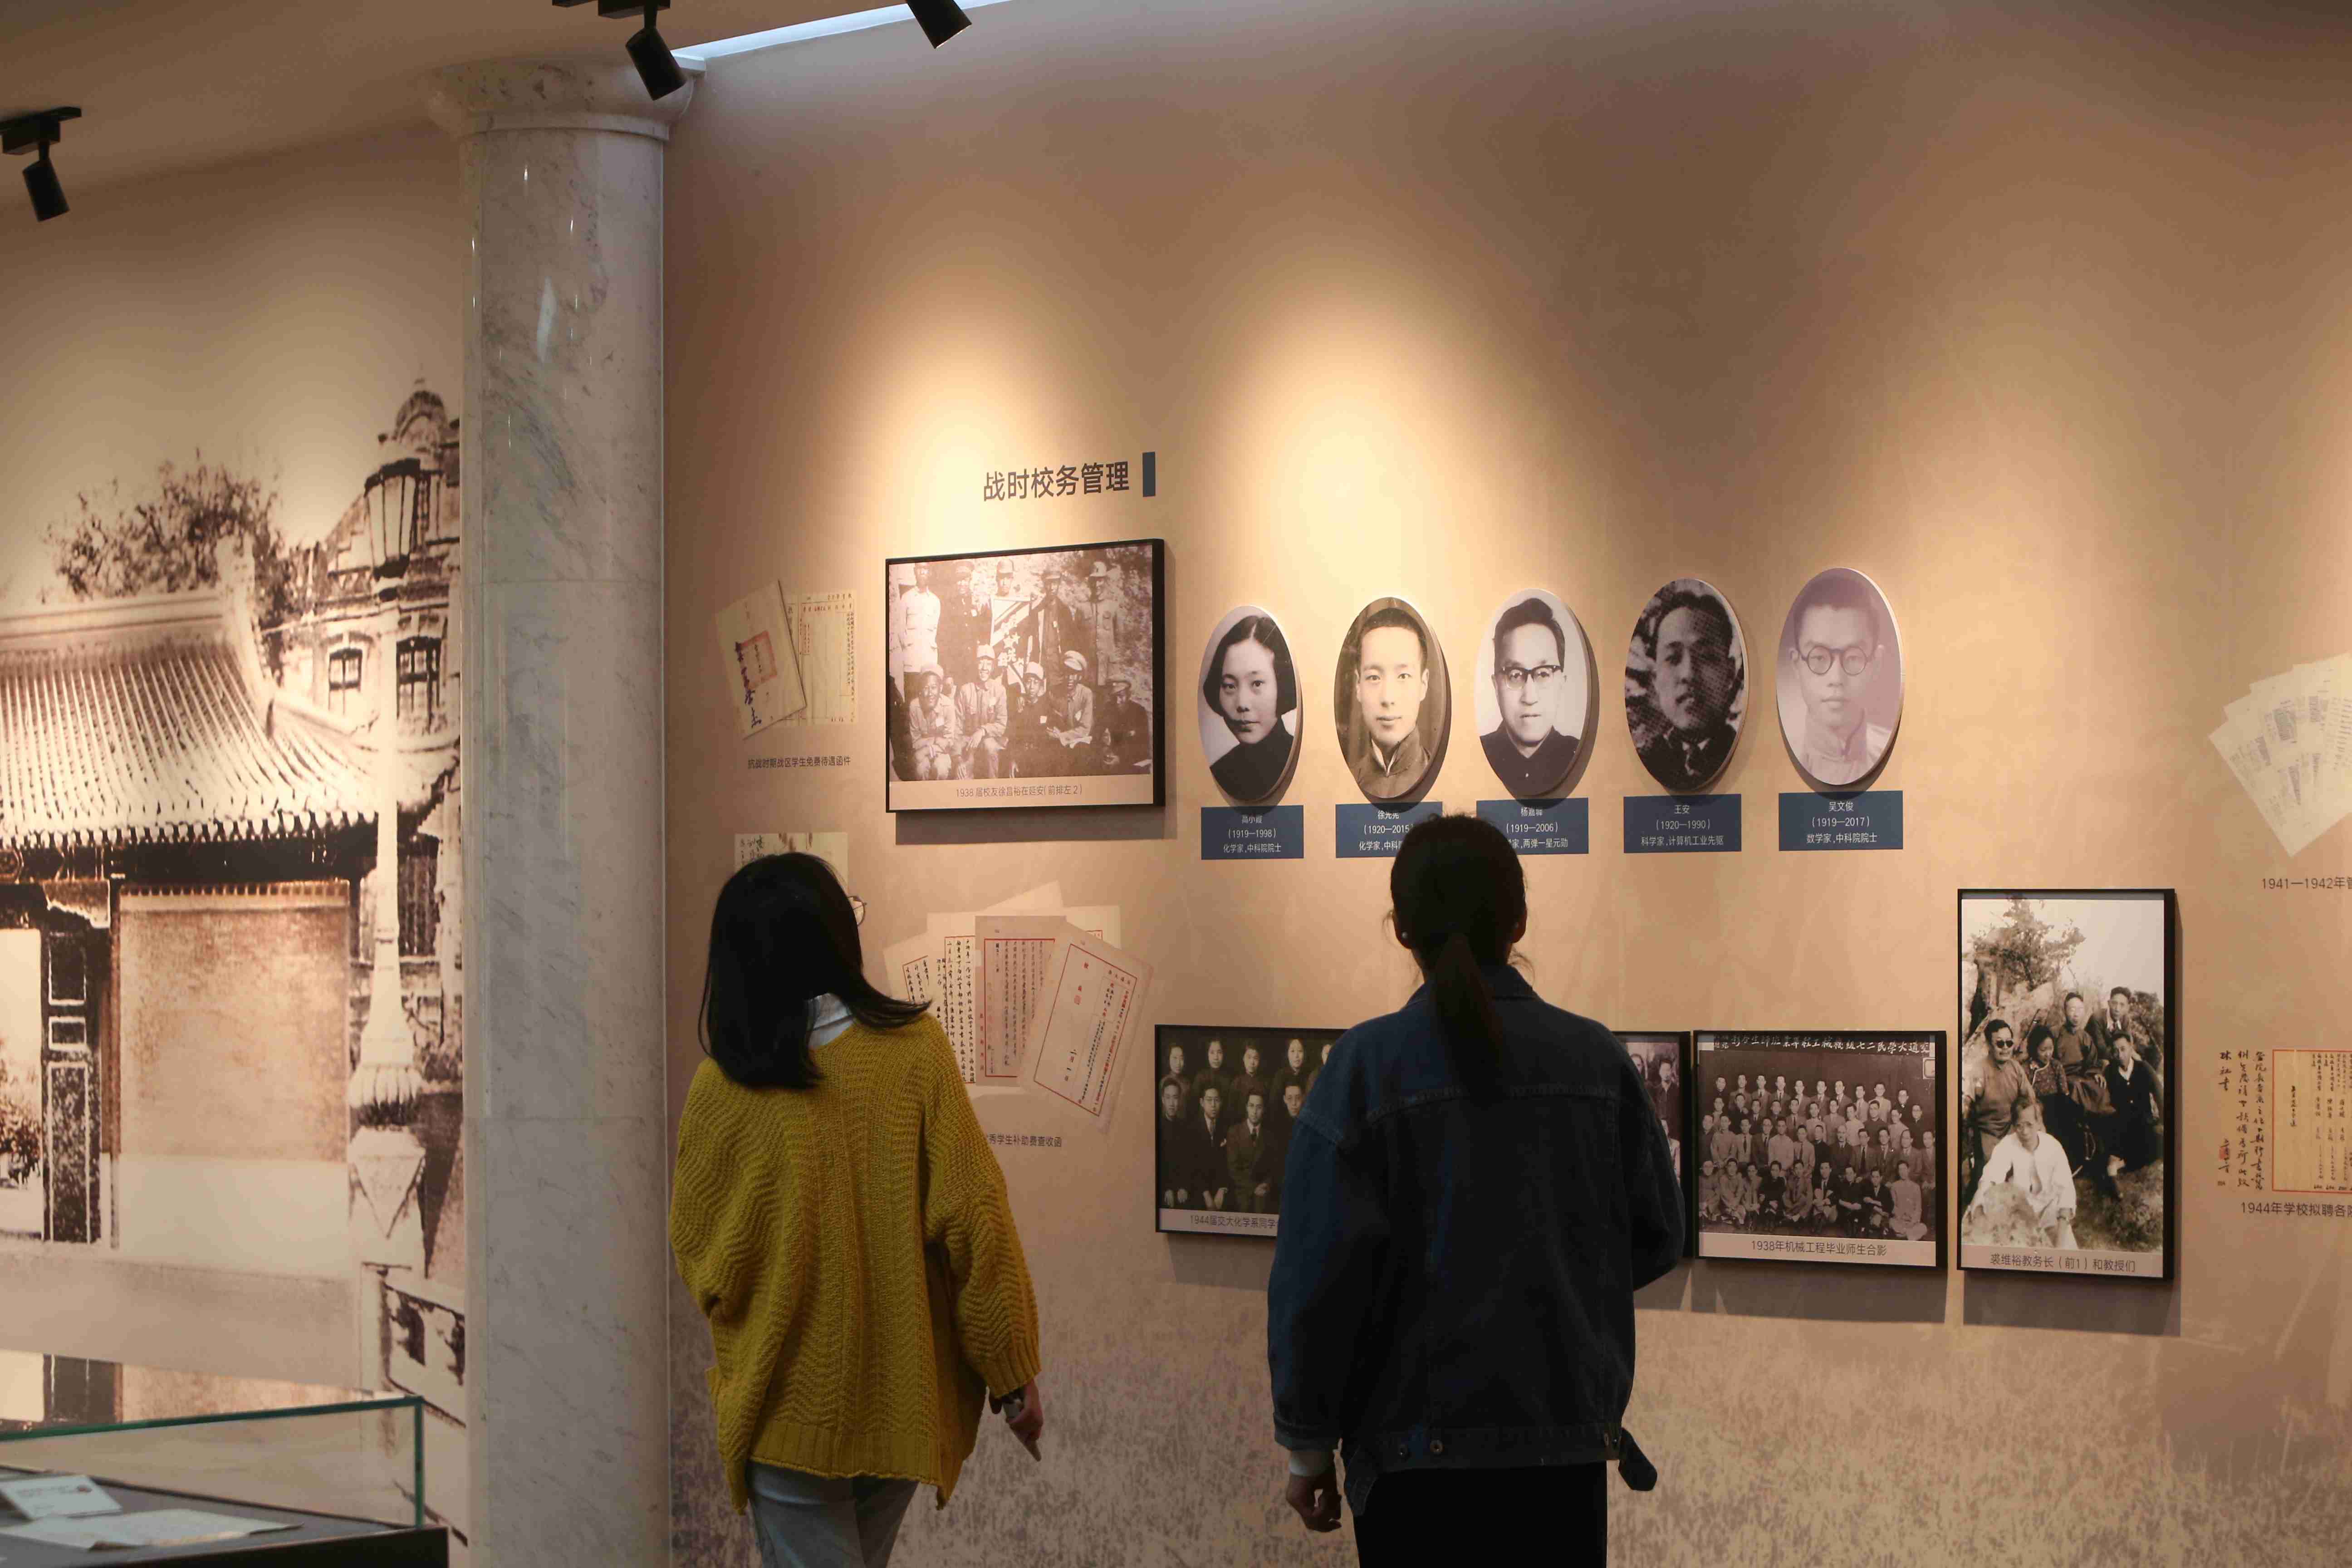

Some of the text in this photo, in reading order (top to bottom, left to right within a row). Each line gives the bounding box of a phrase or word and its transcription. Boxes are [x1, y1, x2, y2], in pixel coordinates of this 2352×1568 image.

[984, 461, 1129, 501] 战时校务管理
[1674, 804, 1690, 814] 王安
[1829, 801, 1854, 812] 吴文俊
[1508, 838, 1568, 849] 家,两弹一星元勋
[987, 1133, 1062, 1147] 秀学生补助费查收函
[1190, 1215, 1278, 1229] 1944届交大化学系同学
[1751, 1240, 1886, 1256] 1938年机械工程毕业师生合影
